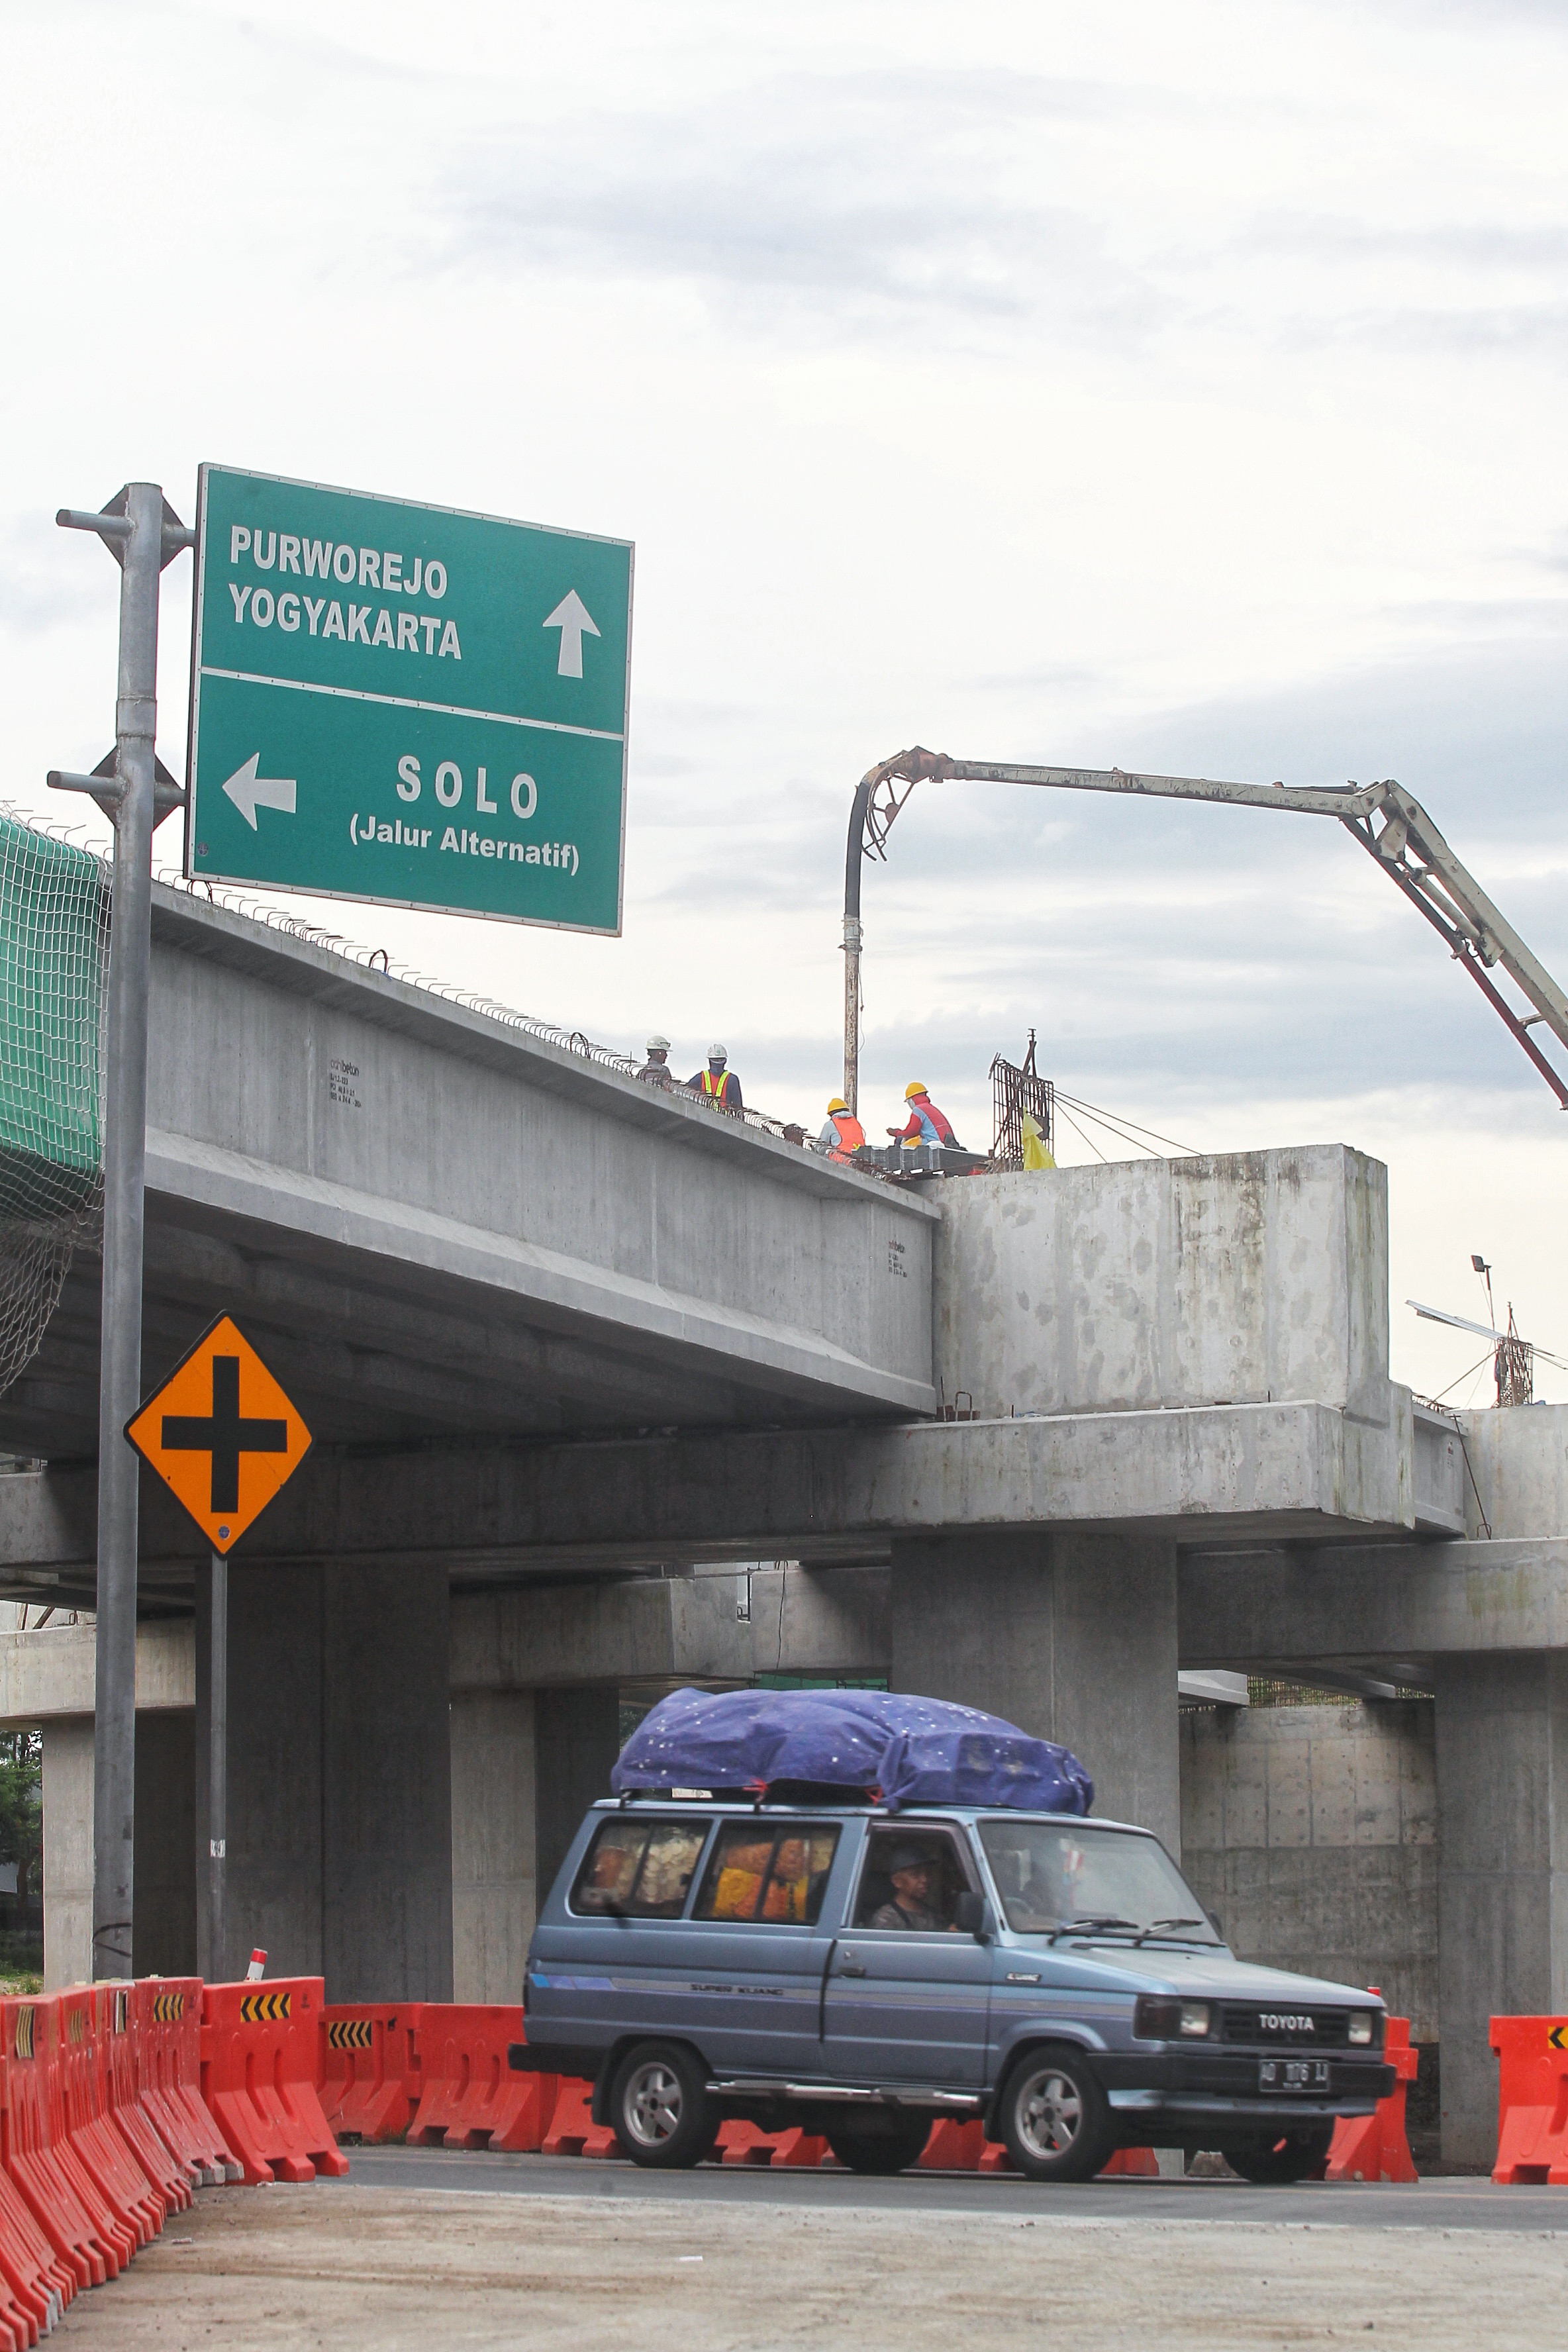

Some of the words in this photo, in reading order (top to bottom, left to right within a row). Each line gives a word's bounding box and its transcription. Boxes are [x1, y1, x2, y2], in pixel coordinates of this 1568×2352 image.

[230, 525, 448, 599] PURWOREJO
[228, 583, 462, 660] YOGYAKARTA
[396, 755, 538, 819] SOLO
[350, 813, 432, 848] (Jalur
[440, 827, 579, 876] Alternatif)
[691, 1983, 732, 1992] SUPER
[738, 1986, 784, 1996] KIJANG
[1258, 2014, 1315, 2030] TOYOTA
